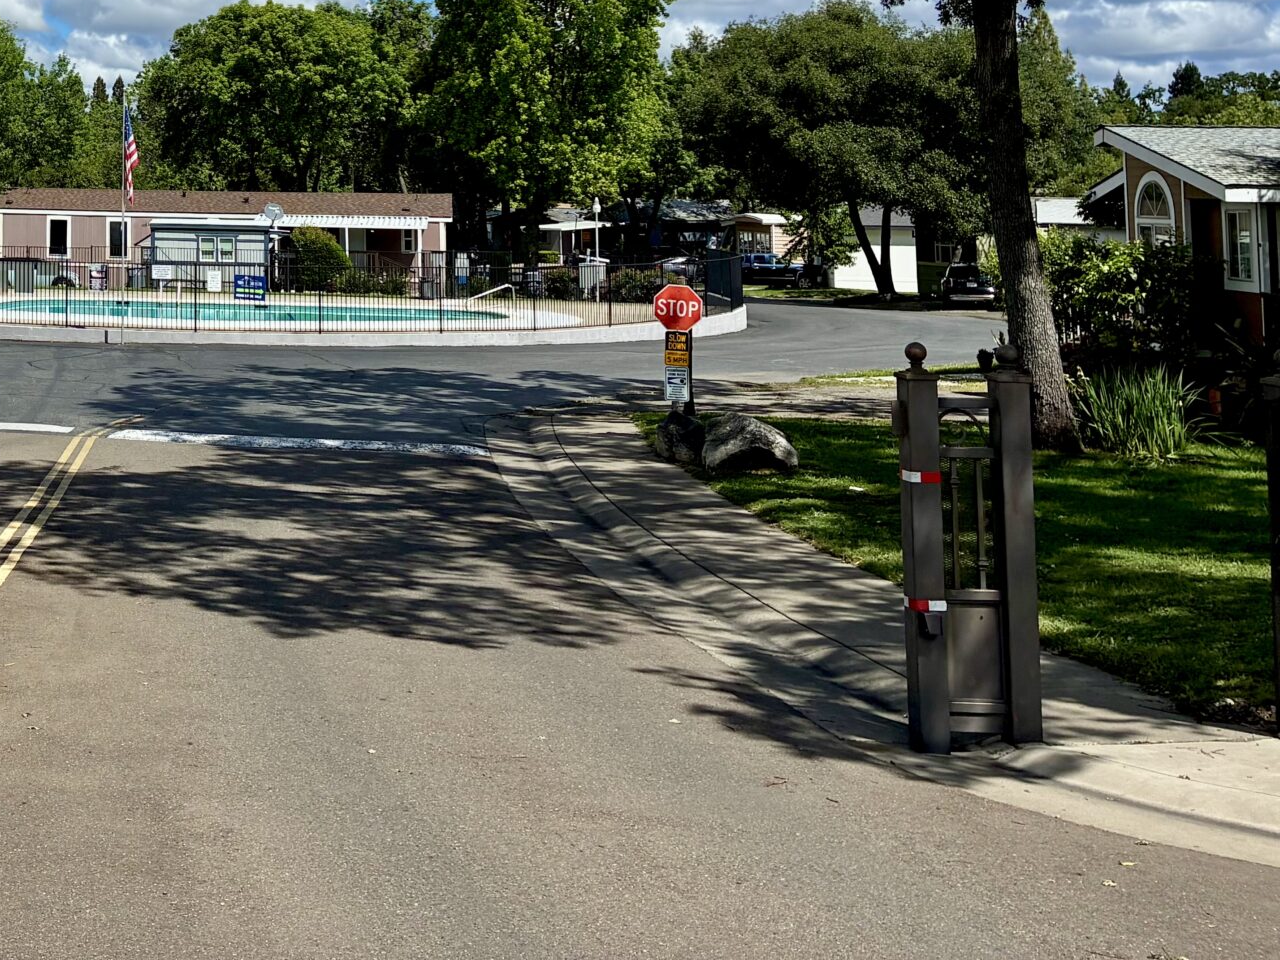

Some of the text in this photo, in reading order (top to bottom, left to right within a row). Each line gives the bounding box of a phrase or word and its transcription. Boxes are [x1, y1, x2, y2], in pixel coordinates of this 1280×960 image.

[657, 298, 698, 317] STOP
[668, 334, 686, 342] SLOW
[668, 342, 686, 350] DOWN
